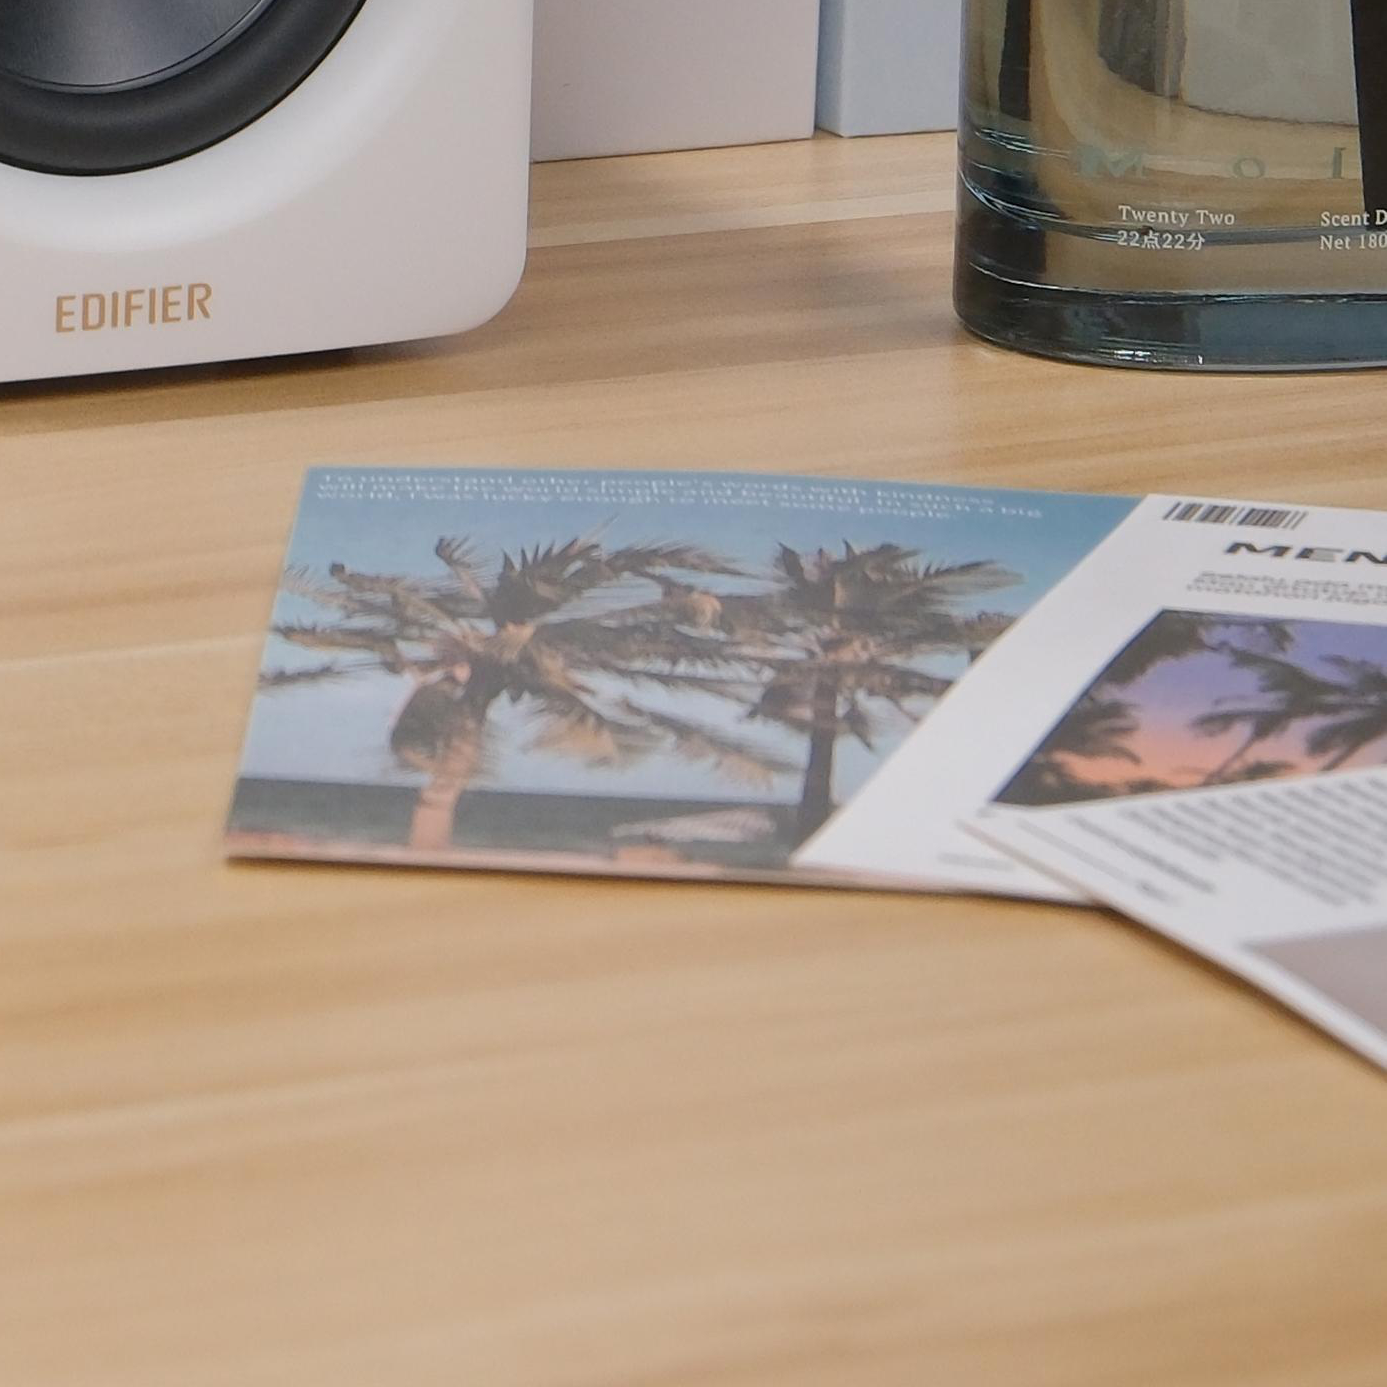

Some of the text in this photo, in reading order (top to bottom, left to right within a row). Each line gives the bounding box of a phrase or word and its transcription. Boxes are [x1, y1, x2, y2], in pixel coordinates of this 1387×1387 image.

[1118, 205, 1236, 226] Twenty Two
[1320, 210, 1370, 227] Scent
[1116, 230, 1206, 251] 22点22分
[1319, 234, 1352, 251] Net
[55, 282, 213, 333] EDIFIER
[361, 474, 513, 485] understand
[522, 476, 591, 486] other
[809, 485, 867, 497] with
[876, 489, 995, 506] kindness
[503, 483, 580, 495] world
